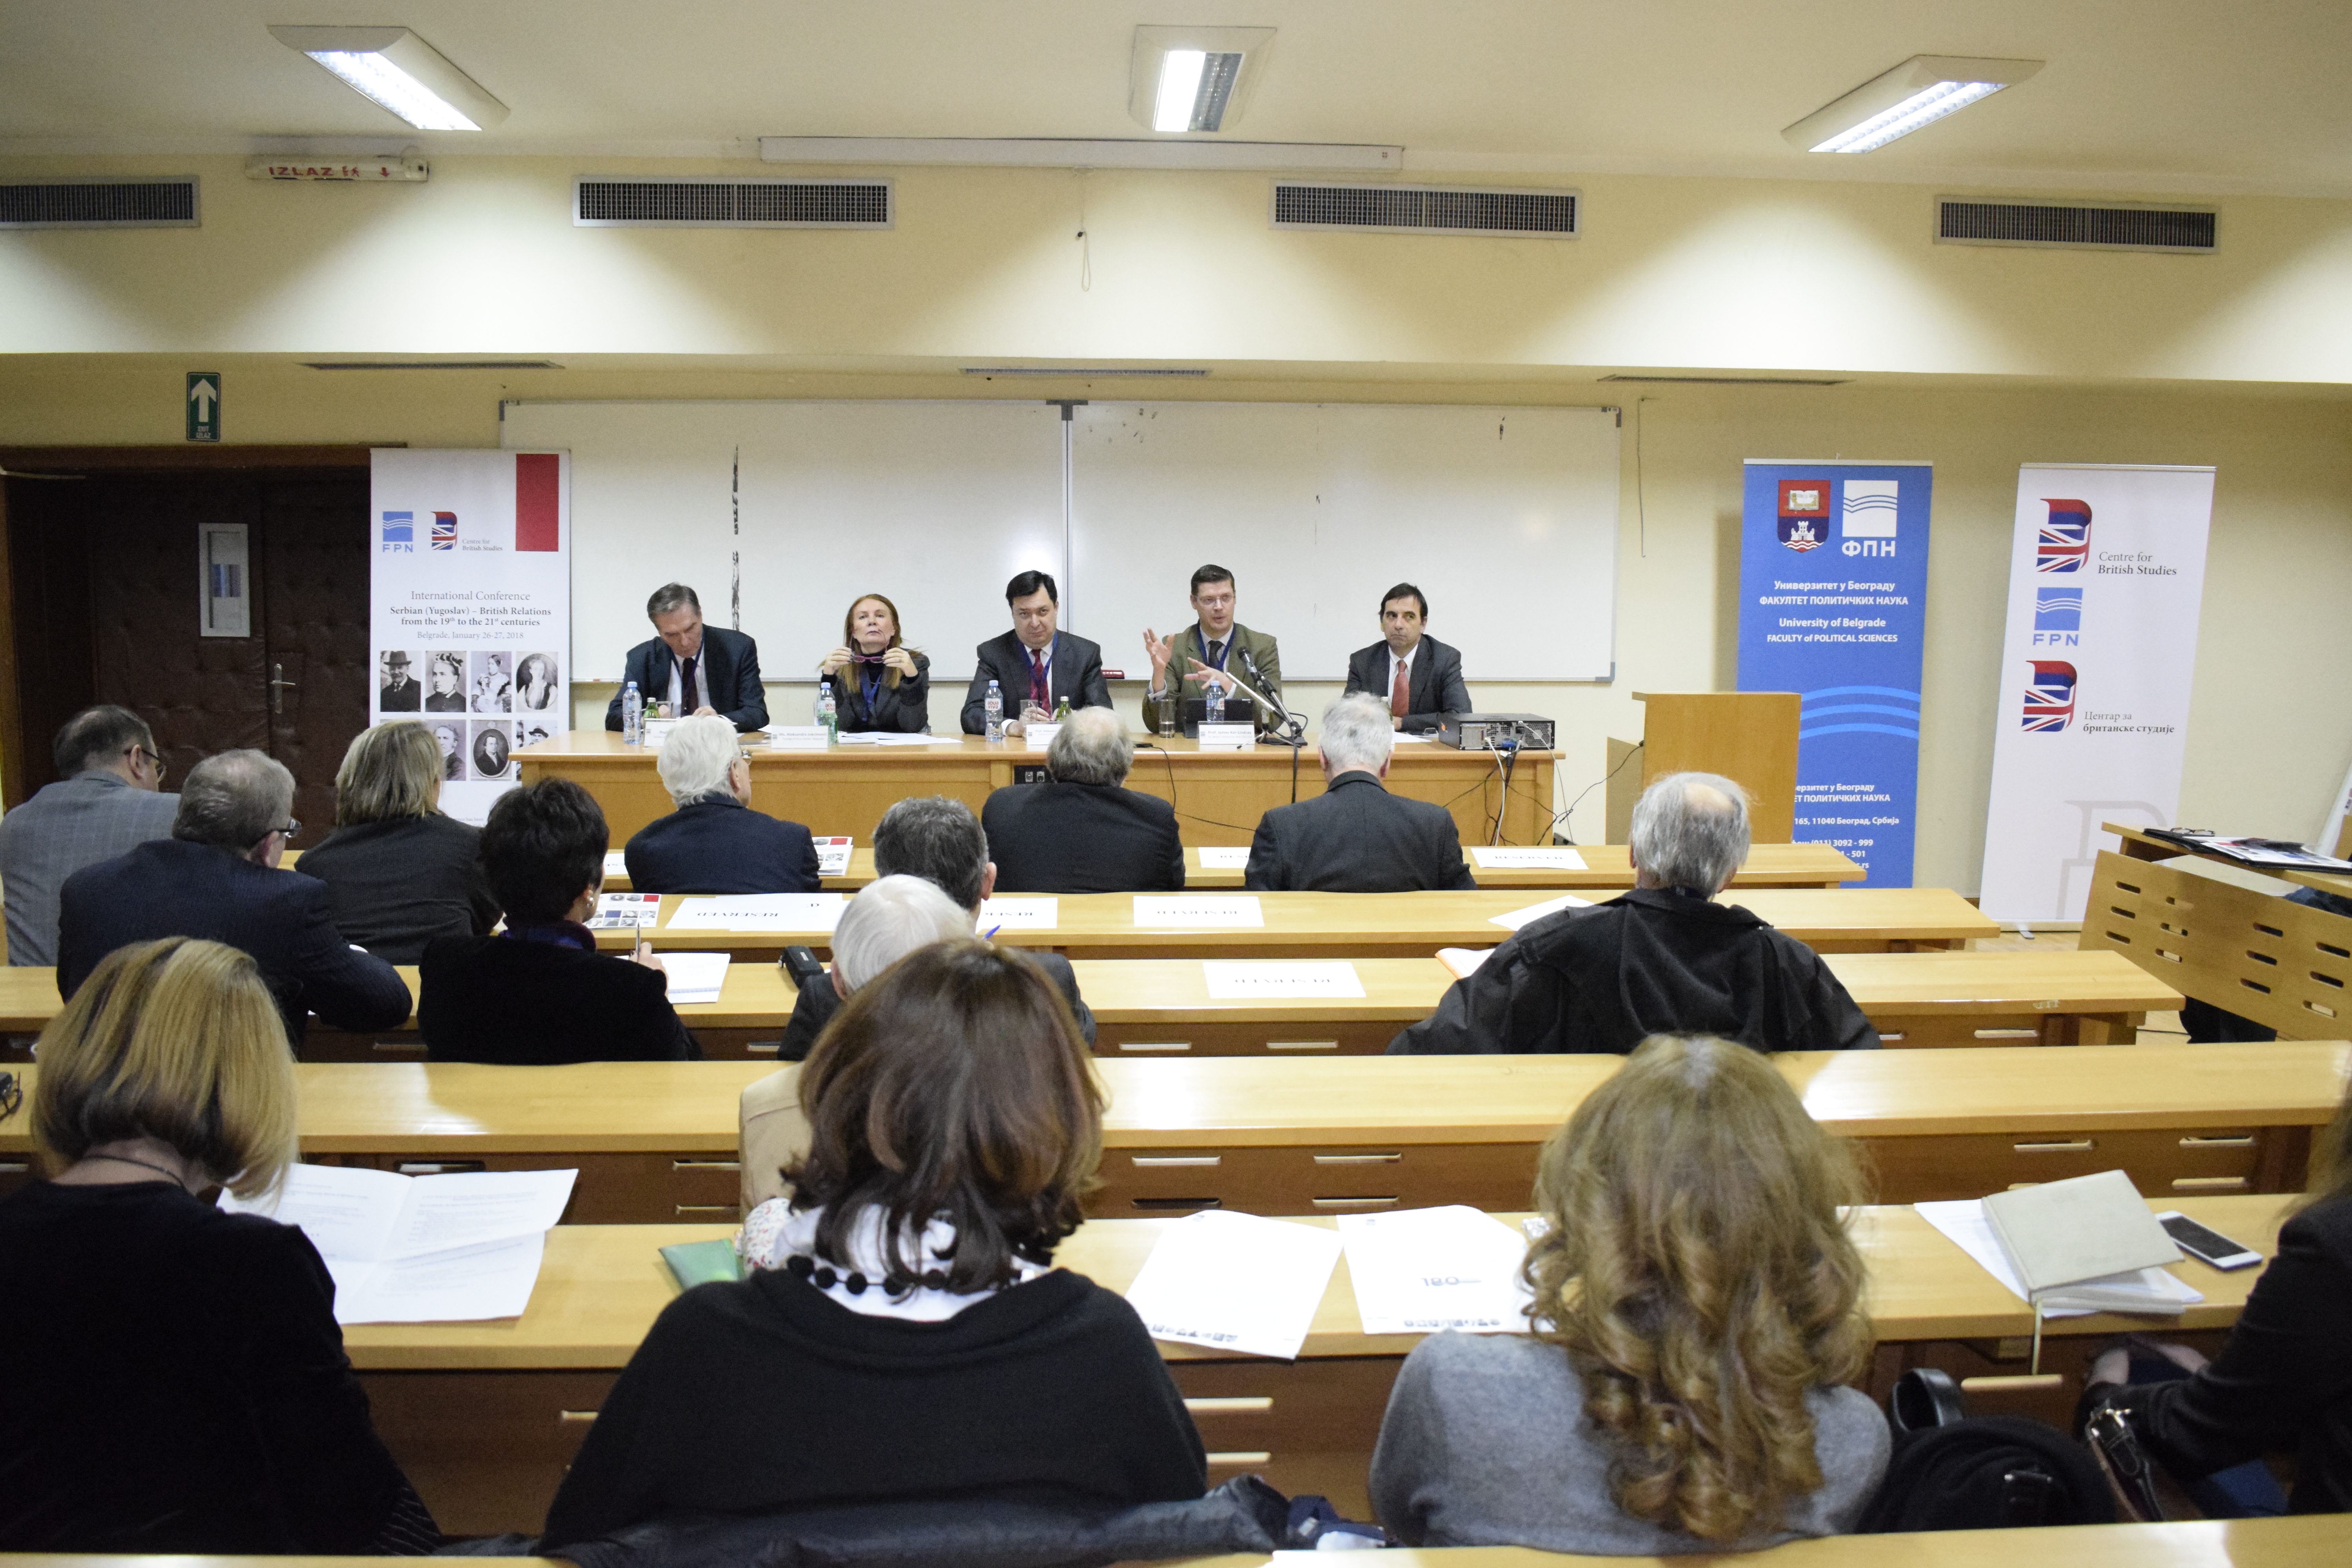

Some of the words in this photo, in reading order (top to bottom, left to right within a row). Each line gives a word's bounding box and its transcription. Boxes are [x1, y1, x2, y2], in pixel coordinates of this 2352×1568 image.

[269, 167, 333, 176] IZLAZ
[383, 544, 413, 553] FPN
[1842, 540, 1896, 557] ФПН
[2099, 552, 2134, 562] Centre
[2137, 552, 2153, 562] for
[2098, 565, 2134, 575] British
[2137, 565, 2177, 575] Studies
[1774, 581, 1838, 590] Универзитет
[1840, 583, 1846, 592] у
[1847, 581, 1895, 592] Београду
[411, 590, 473, 600] International
[476, 591, 530, 601] Conference
[1759, 596, 1808, 605] ФАКУЛТЕТ
[1810, 596, 1874, 605] ПОЛИТИЧКИХ
[1876, 596, 1908, 605] НАУКА
[390, 606, 423, 615] Serbian
[425, 607, 470, 616] (Yugoslav)
[480, 607, 508, 615] British
[511, 607, 552, 615] Relations
[401, 617, 422, 625] from
[425, 617, 437, 625] the
[441, 616, 456, 625] 19th
[469, 617, 483, 626] the
[485, 617, 499, 626] 21st
[501, 618, 540, 626] centuries
[1779, 618, 1829, 629] University
[1831, 617, 1841, 626] of
[1843, 618, 1886, 629] Belgrade
[417, 631, 450, 640] Belgrade,
[452, 632, 480, 641] January
[2033, 633, 2079, 646] FPN
[2084, 711, 2120, 722] Центар
[2083, 724, 2134, 735] британске
[2136, 724, 2175, 735] студије
[1795, 784, 1829, 793] ерзитет
[1837, 784, 1875, 792] Београду
[1837, 817, 1871, 826] Београд,
[1872, 817, 1899, 825] Србија
